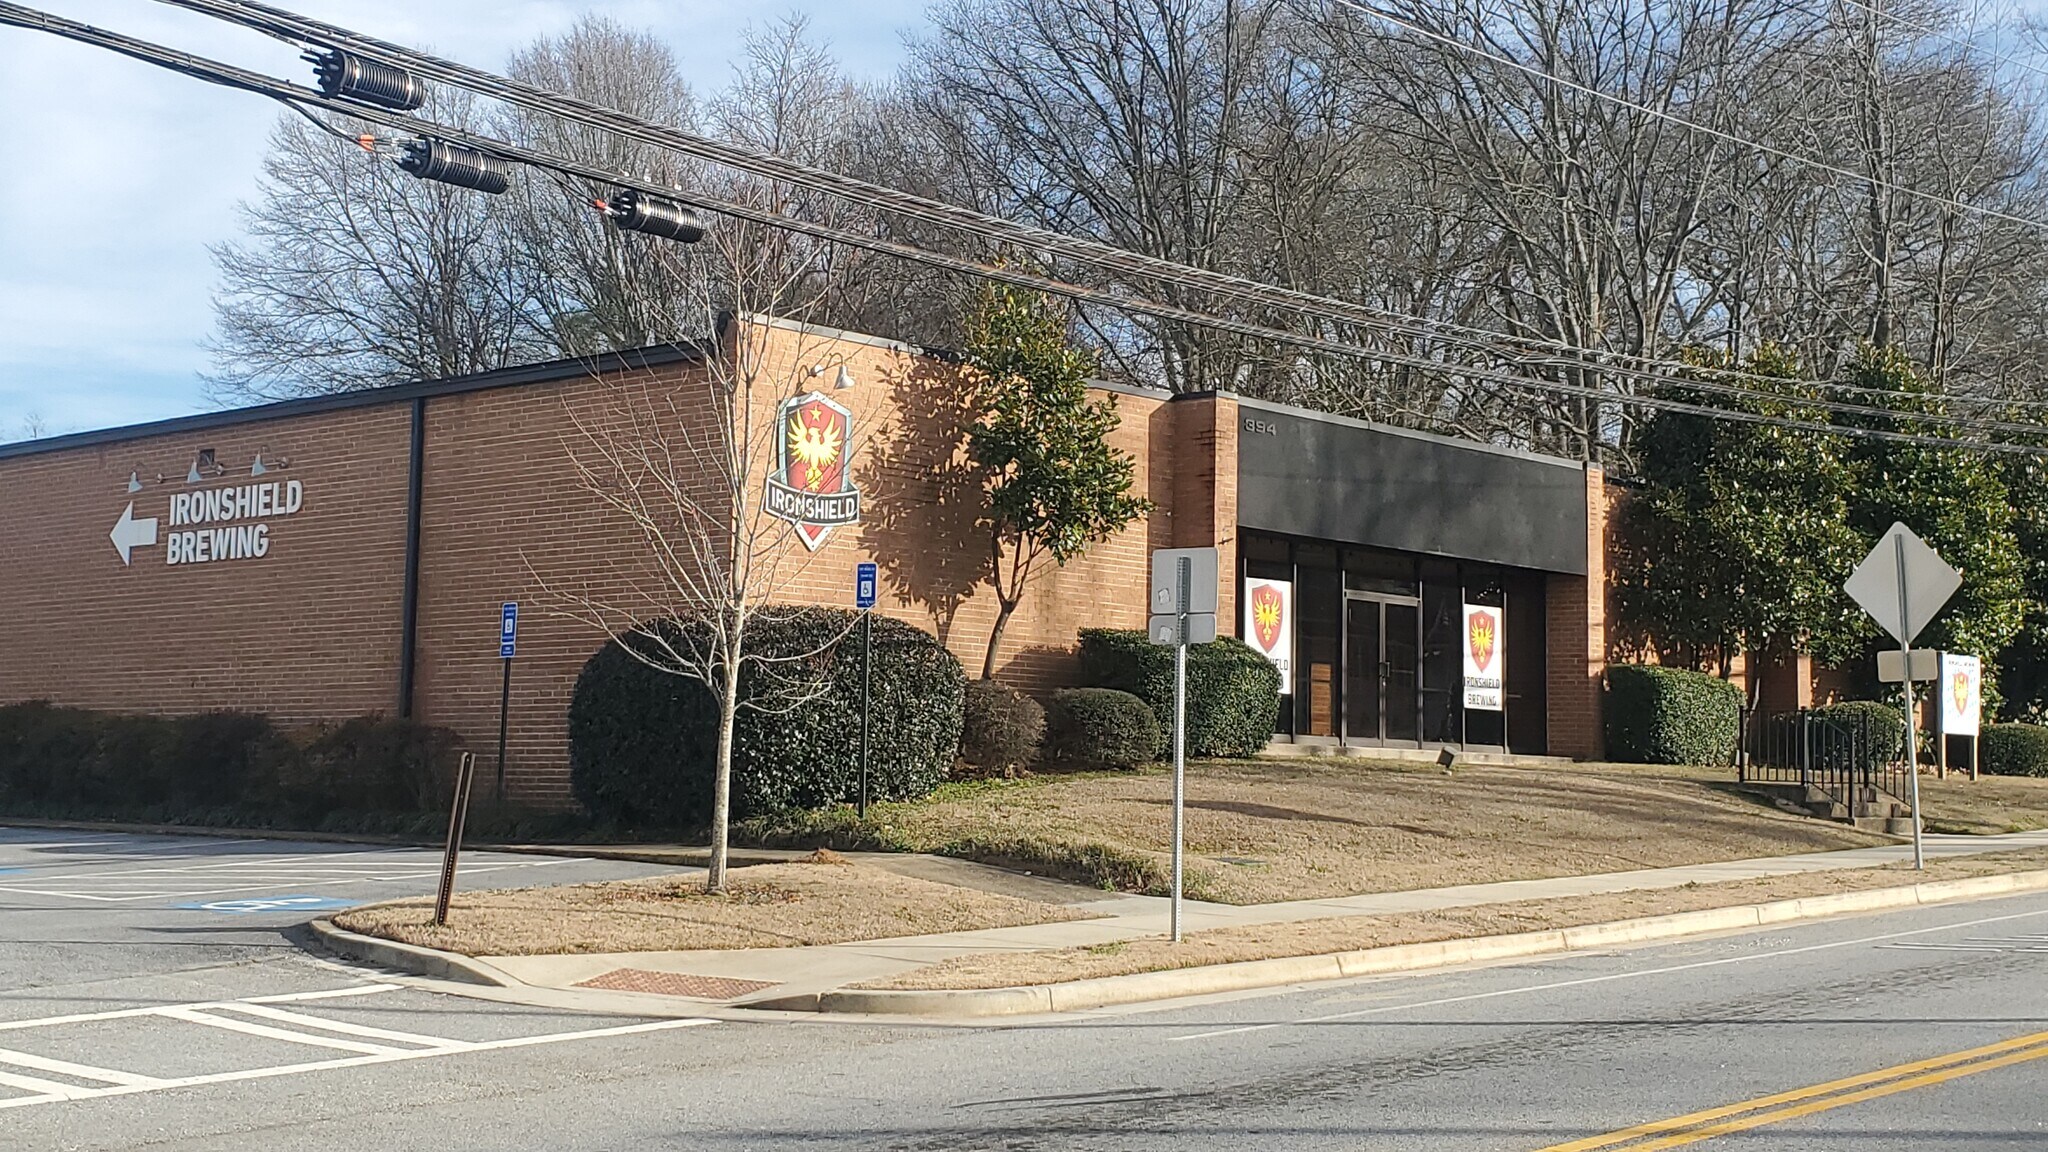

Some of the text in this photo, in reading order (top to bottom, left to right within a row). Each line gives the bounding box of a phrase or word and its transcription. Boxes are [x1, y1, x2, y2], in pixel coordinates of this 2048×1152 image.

[1245, 418, 1277, 436] 394
[169, 480, 303, 526] IRONSHIELD
[771, 487, 855, 520] IRONSHIELD
[166, 523, 270, 565] BREWING
[1463, 676, 1500, 689] IRONSHIELD
[1467, 693, 1497, 706] BREWING
